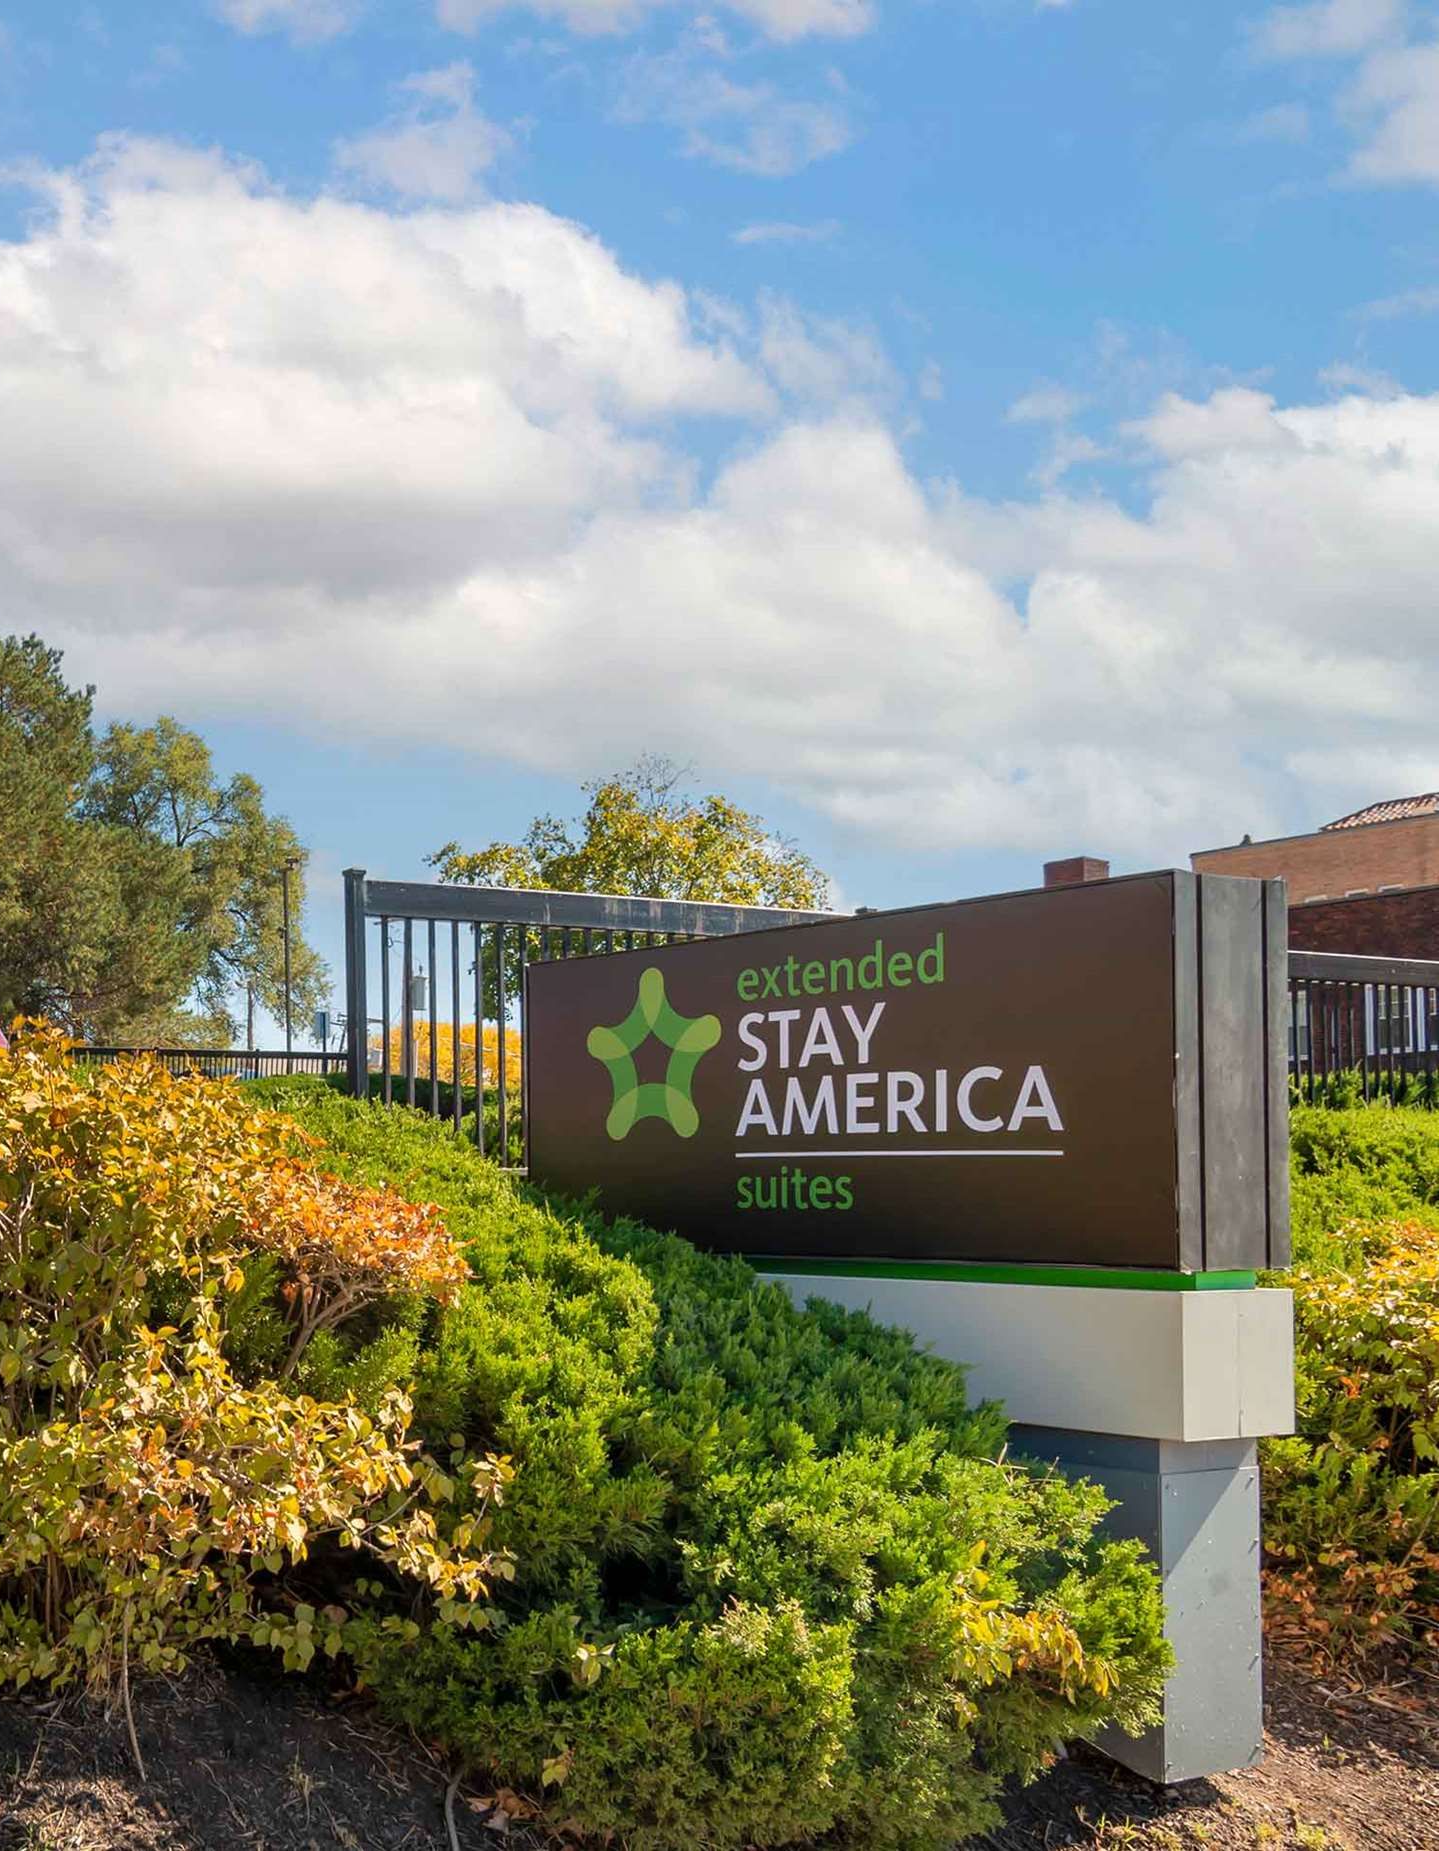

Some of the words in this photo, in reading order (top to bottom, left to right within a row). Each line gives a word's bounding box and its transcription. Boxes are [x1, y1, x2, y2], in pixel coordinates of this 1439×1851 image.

[736, 932, 945, 1001] extended
[736, 1002, 886, 1072] STAY
[735, 1064, 1064, 1137] AMERICA
[735, 1166, 855, 1211] suites
